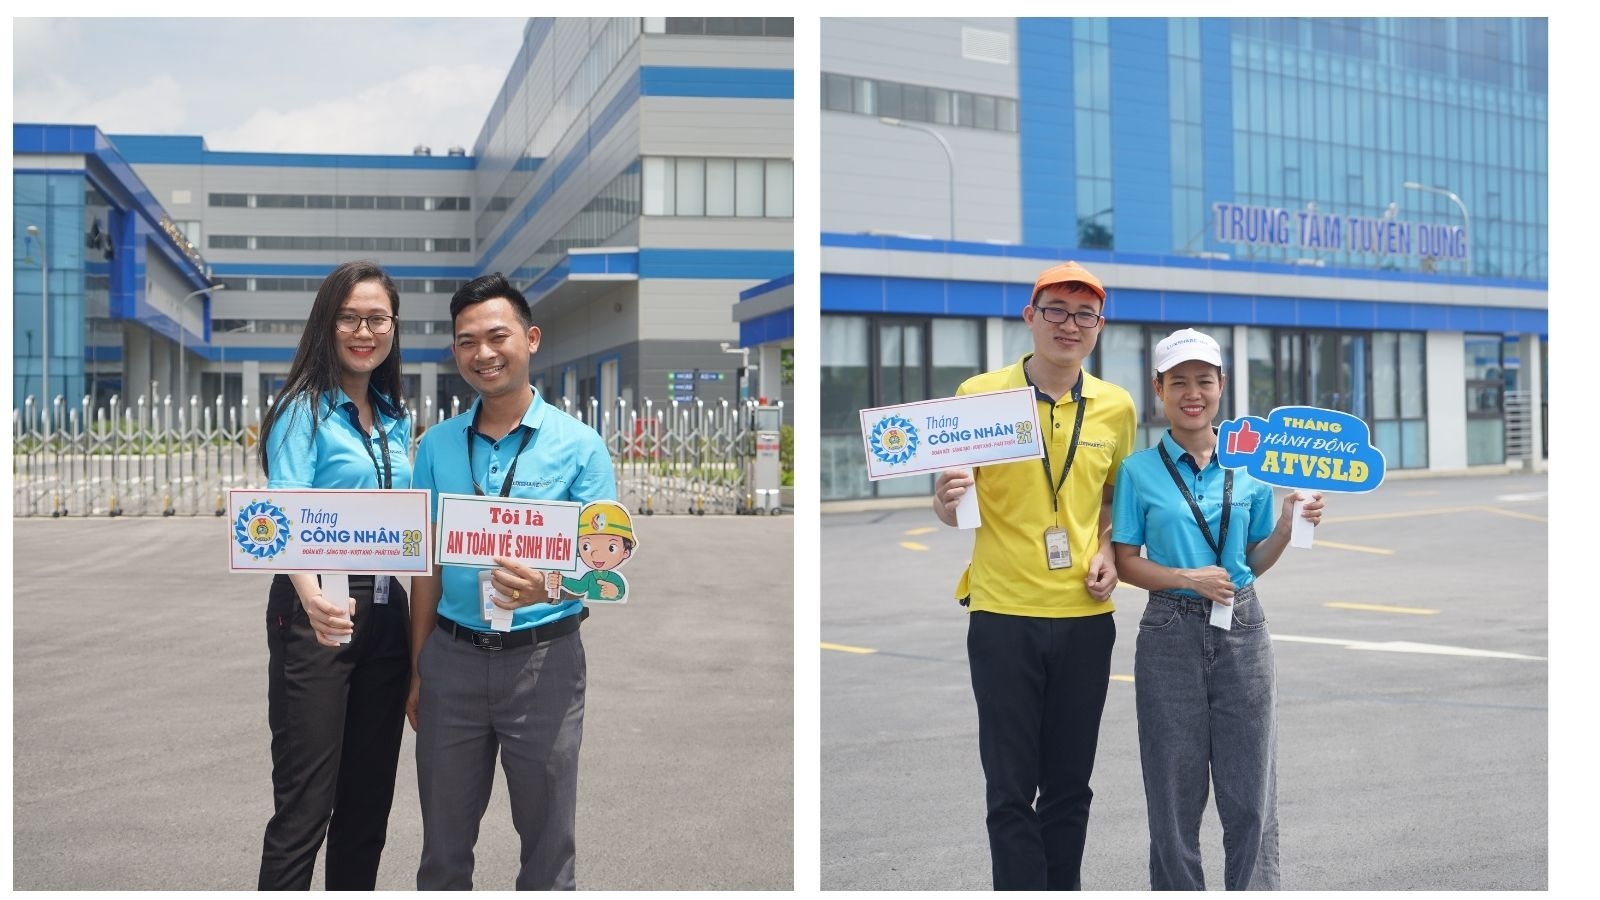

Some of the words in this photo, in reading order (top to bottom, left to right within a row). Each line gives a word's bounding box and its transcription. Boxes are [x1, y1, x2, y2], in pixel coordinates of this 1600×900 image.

[1214, 203, 1290, 246] TRUNG
[925, 416, 959, 430] Tháng
[1015, 420, 1033, 434] 20
[1282, 416, 1342, 433] THÁNG
[928, 429, 972, 446] CÔNG
[974, 423, 1014, 440] NHÂN
[1016, 432, 1033, 445] 21
[1263, 432, 1313, 448] HÀNH
[1313, 437, 1359, 455] ĐỘNG
[1260, 450, 1369, 483] ATVSLĐ
[300, 508, 338, 528] Tháng
[489, 507, 520, 525] Tôi
[525, 509, 544, 526] là
[300, 526, 350, 543] CÔNG
[354, 527, 400, 544] NHÂN
[402, 529, 422, 543] 20
[402, 542, 421, 556] 21
[446, 530, 463, 554] AN
[466, 528, 496, 556] TOÀN
[515, 534, 543, 559] SINH
[545, 532, 572, 561] VIÊN
